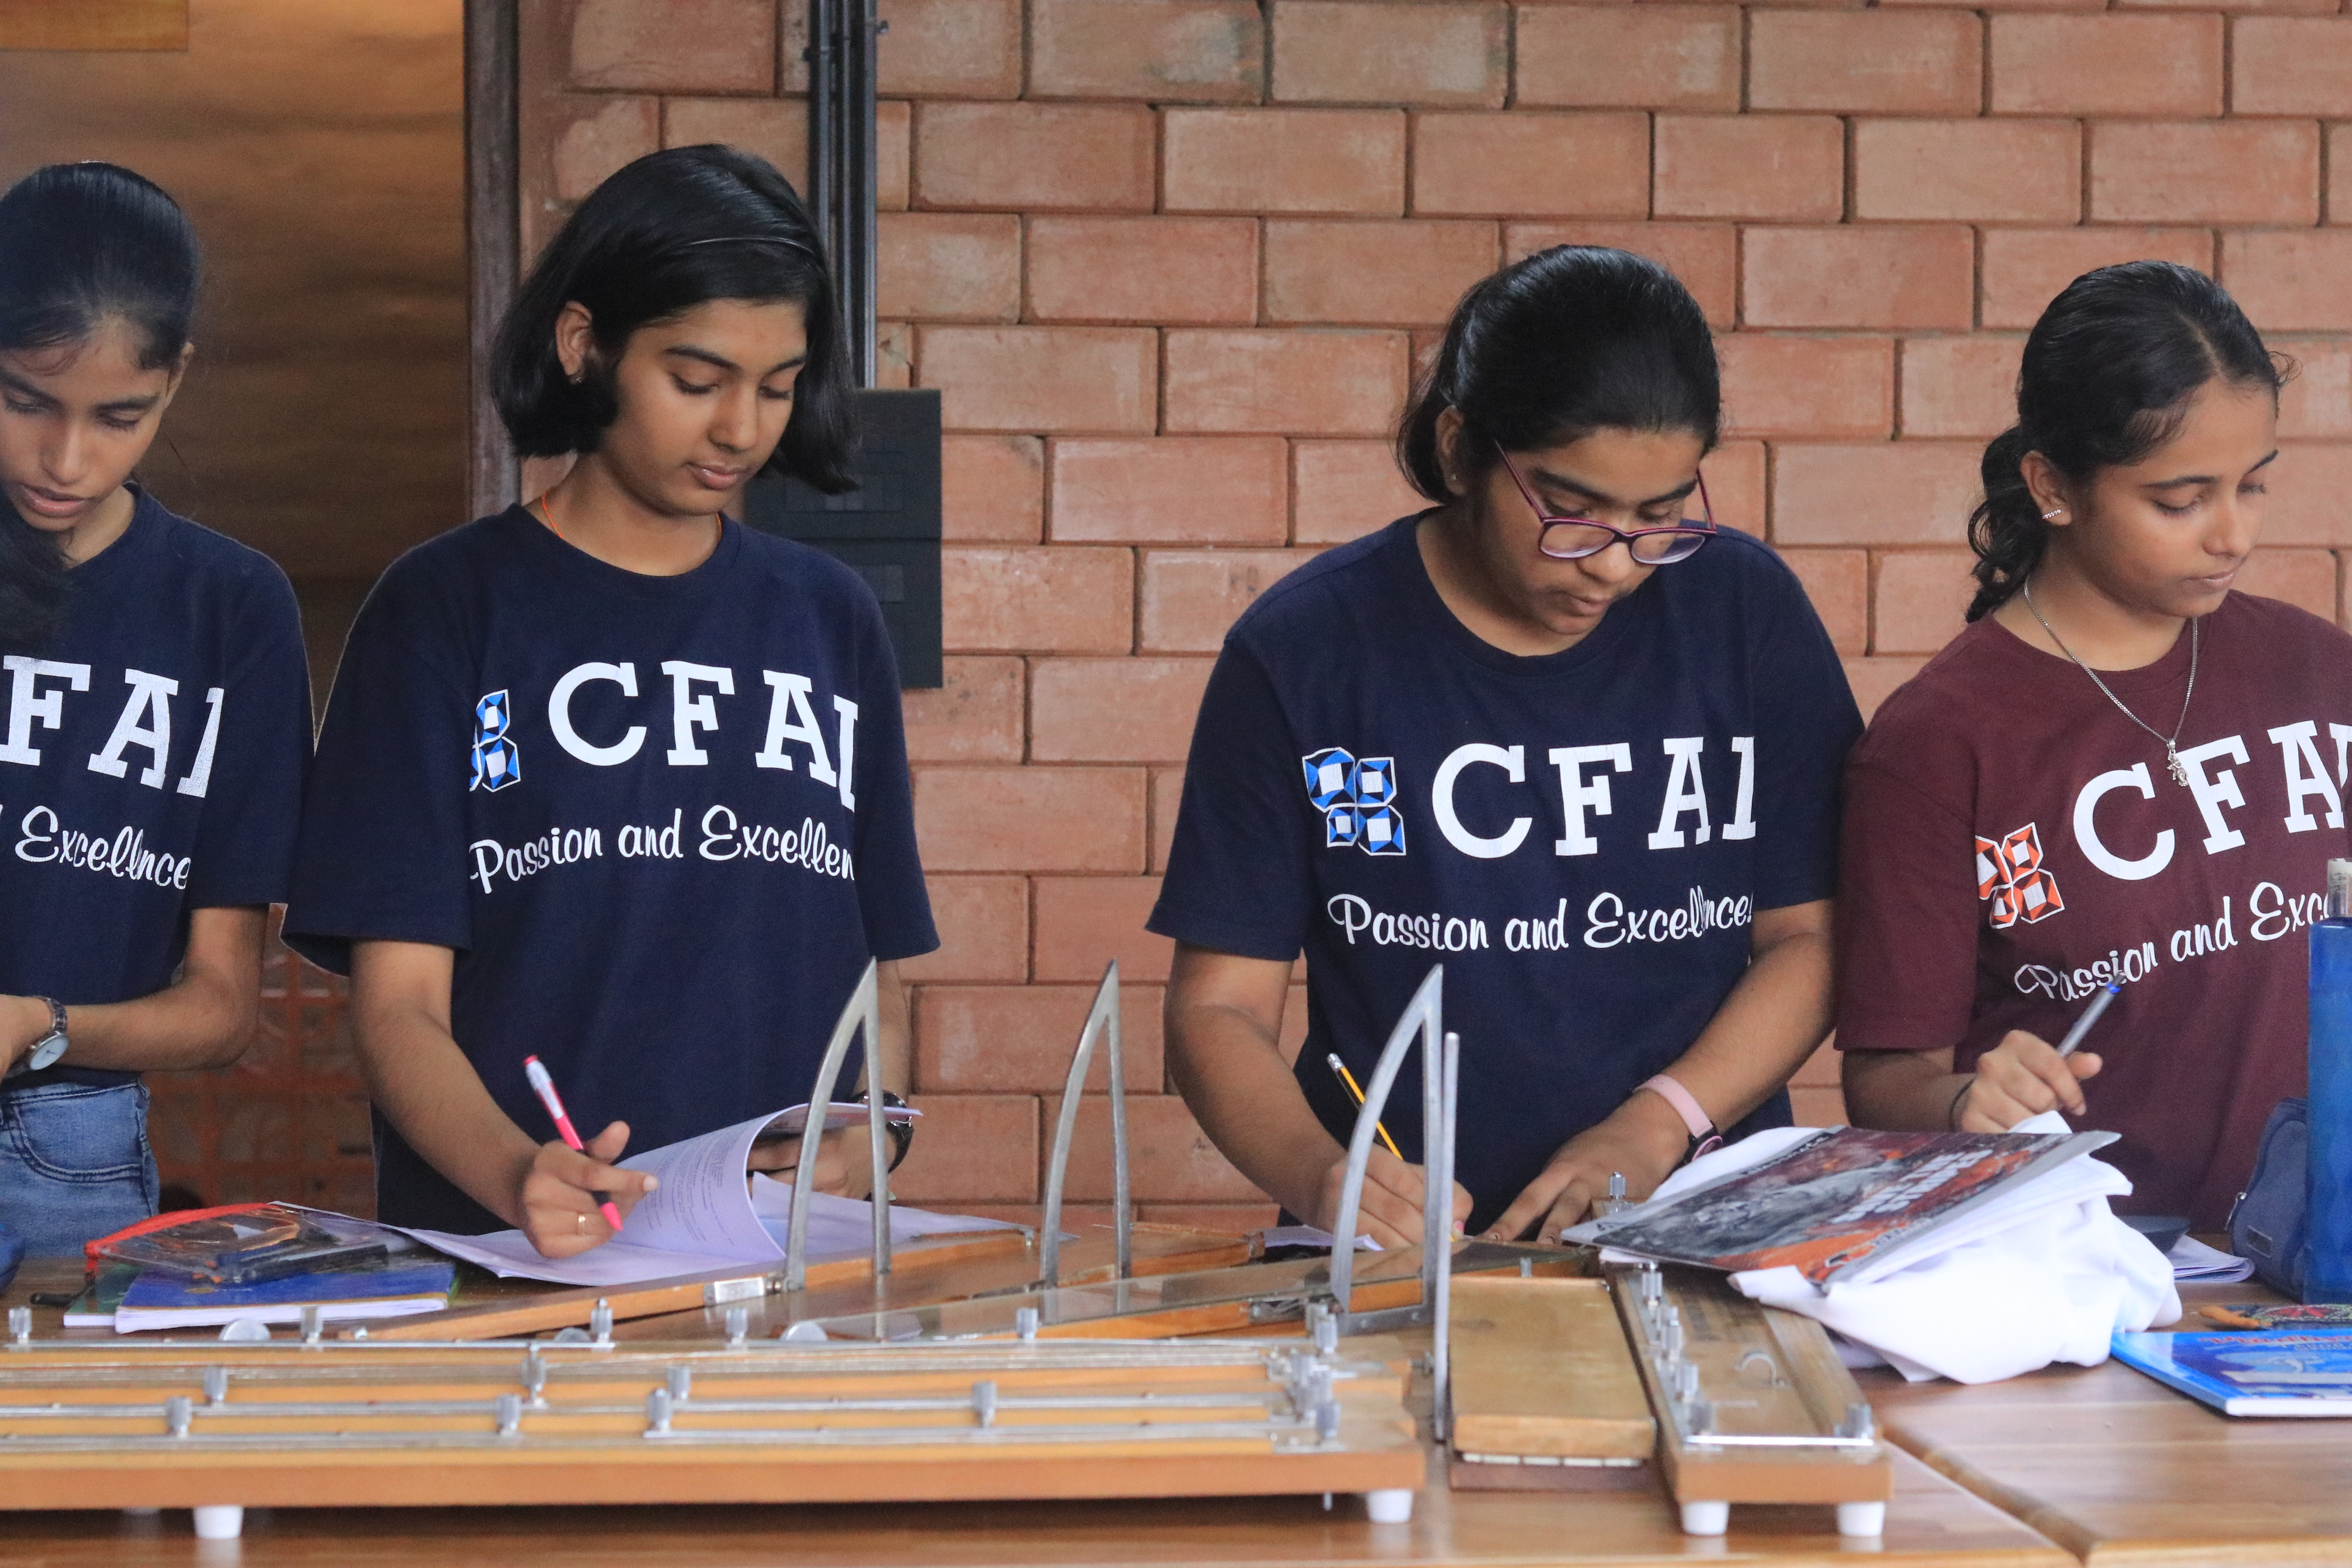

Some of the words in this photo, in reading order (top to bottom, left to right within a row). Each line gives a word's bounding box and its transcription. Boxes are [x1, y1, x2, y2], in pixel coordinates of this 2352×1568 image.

[469, 827, 603, 894] Passion
[618, 808, 684, 859] and
[1328, 894, 1489, 952] Passion
[1505, 898, 1569, 952] and
[2014, 942, 2158, 1001] Passion
[2171, 896, 2238, 962] and
